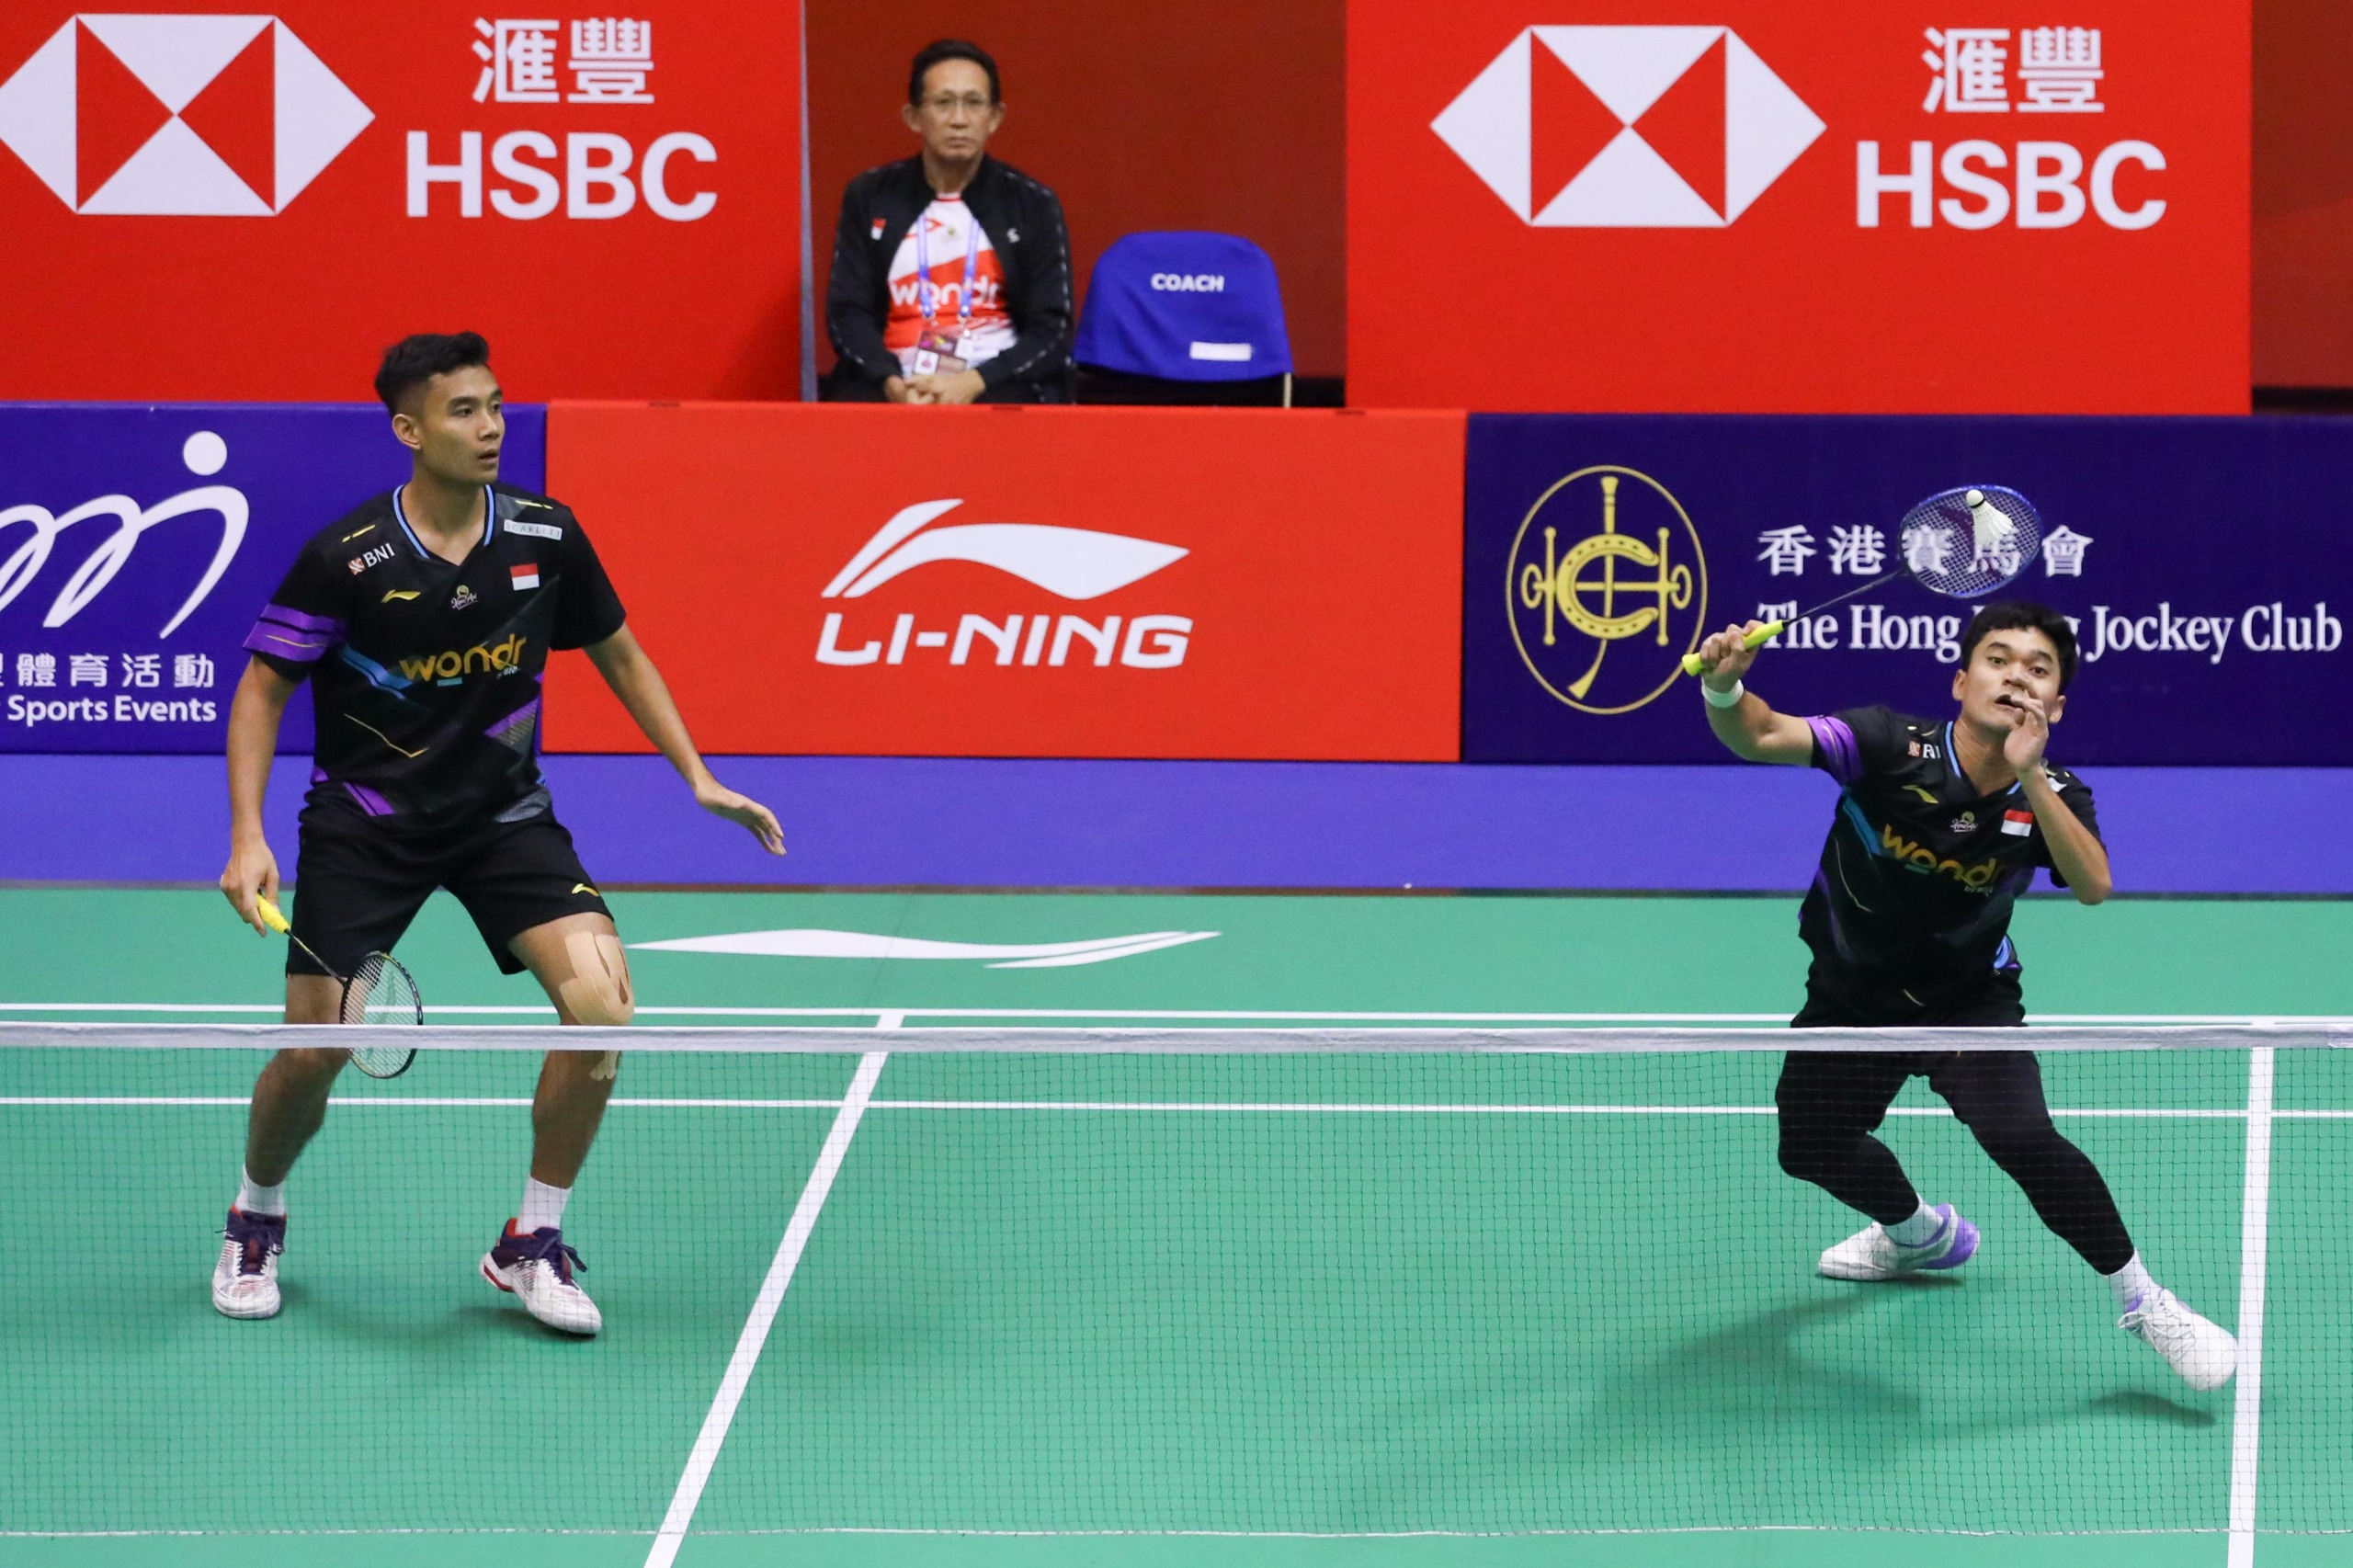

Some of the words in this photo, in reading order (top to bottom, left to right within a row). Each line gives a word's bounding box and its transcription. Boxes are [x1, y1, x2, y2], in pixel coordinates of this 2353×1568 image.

[406, 130, 718, 222] HSBC
[1856, 139, 2167, 230] HSBC
[1151, 273, 1225, 292] COACH
[363, 542, 395, 568] BNI
[399, 633, 527, 682] wondr
[815, 613, 1193, 668] LI-NING
[1756, 600, 1838, 649] The
[1848, 603, 1961, 663] Hong
[2085, 601, 2234, 665] Jockey
[2241, 601, 2343, 652] Club
[0, 653, 215, 688] 體育活動
[7, 694, 108, 727] Sports
[114, 695, 217, 722] Events
[1882, 824, 1998, 888] wond
